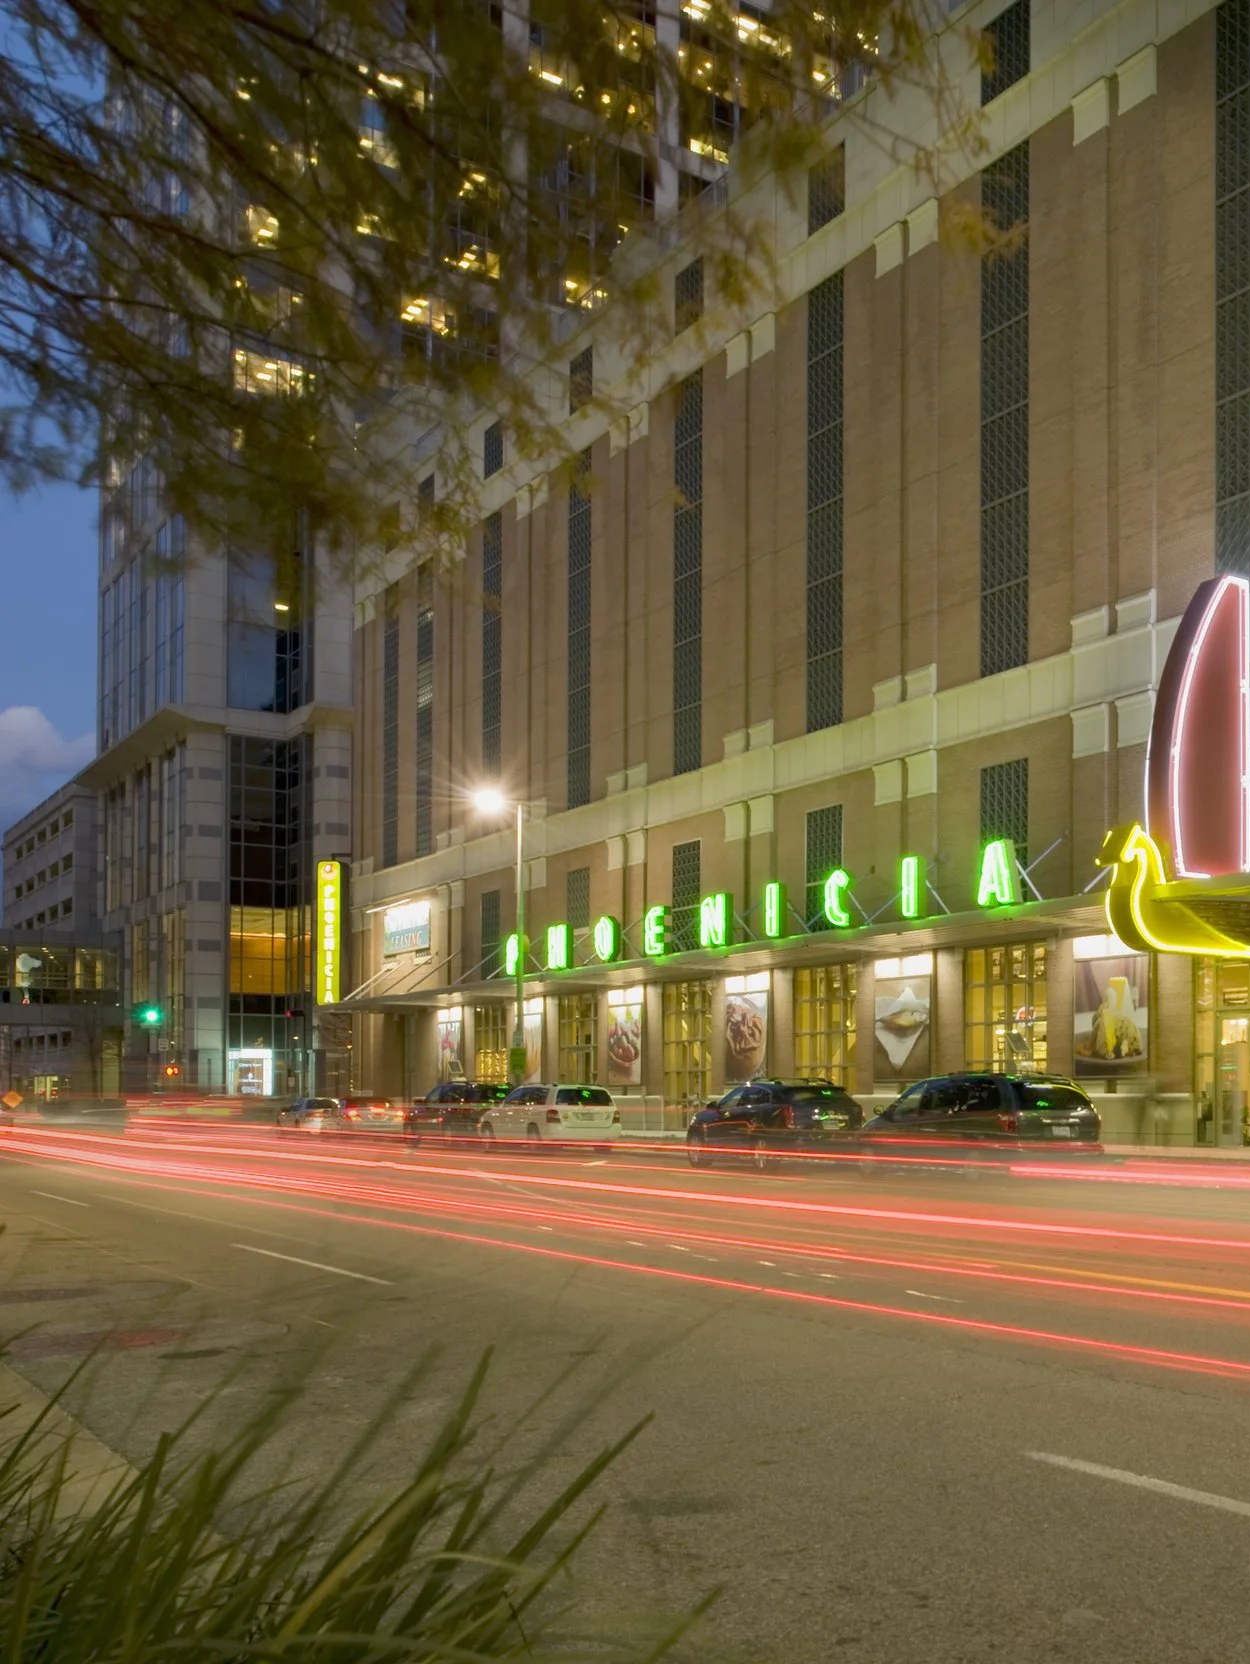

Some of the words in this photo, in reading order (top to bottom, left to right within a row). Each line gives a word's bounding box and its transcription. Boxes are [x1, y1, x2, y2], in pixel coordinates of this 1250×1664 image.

[323, 884, 335, 1004] PHOENICIA
[391, 931, 422, 951] LEASING
[505, 839, 1019, 976] PHOENICIA
